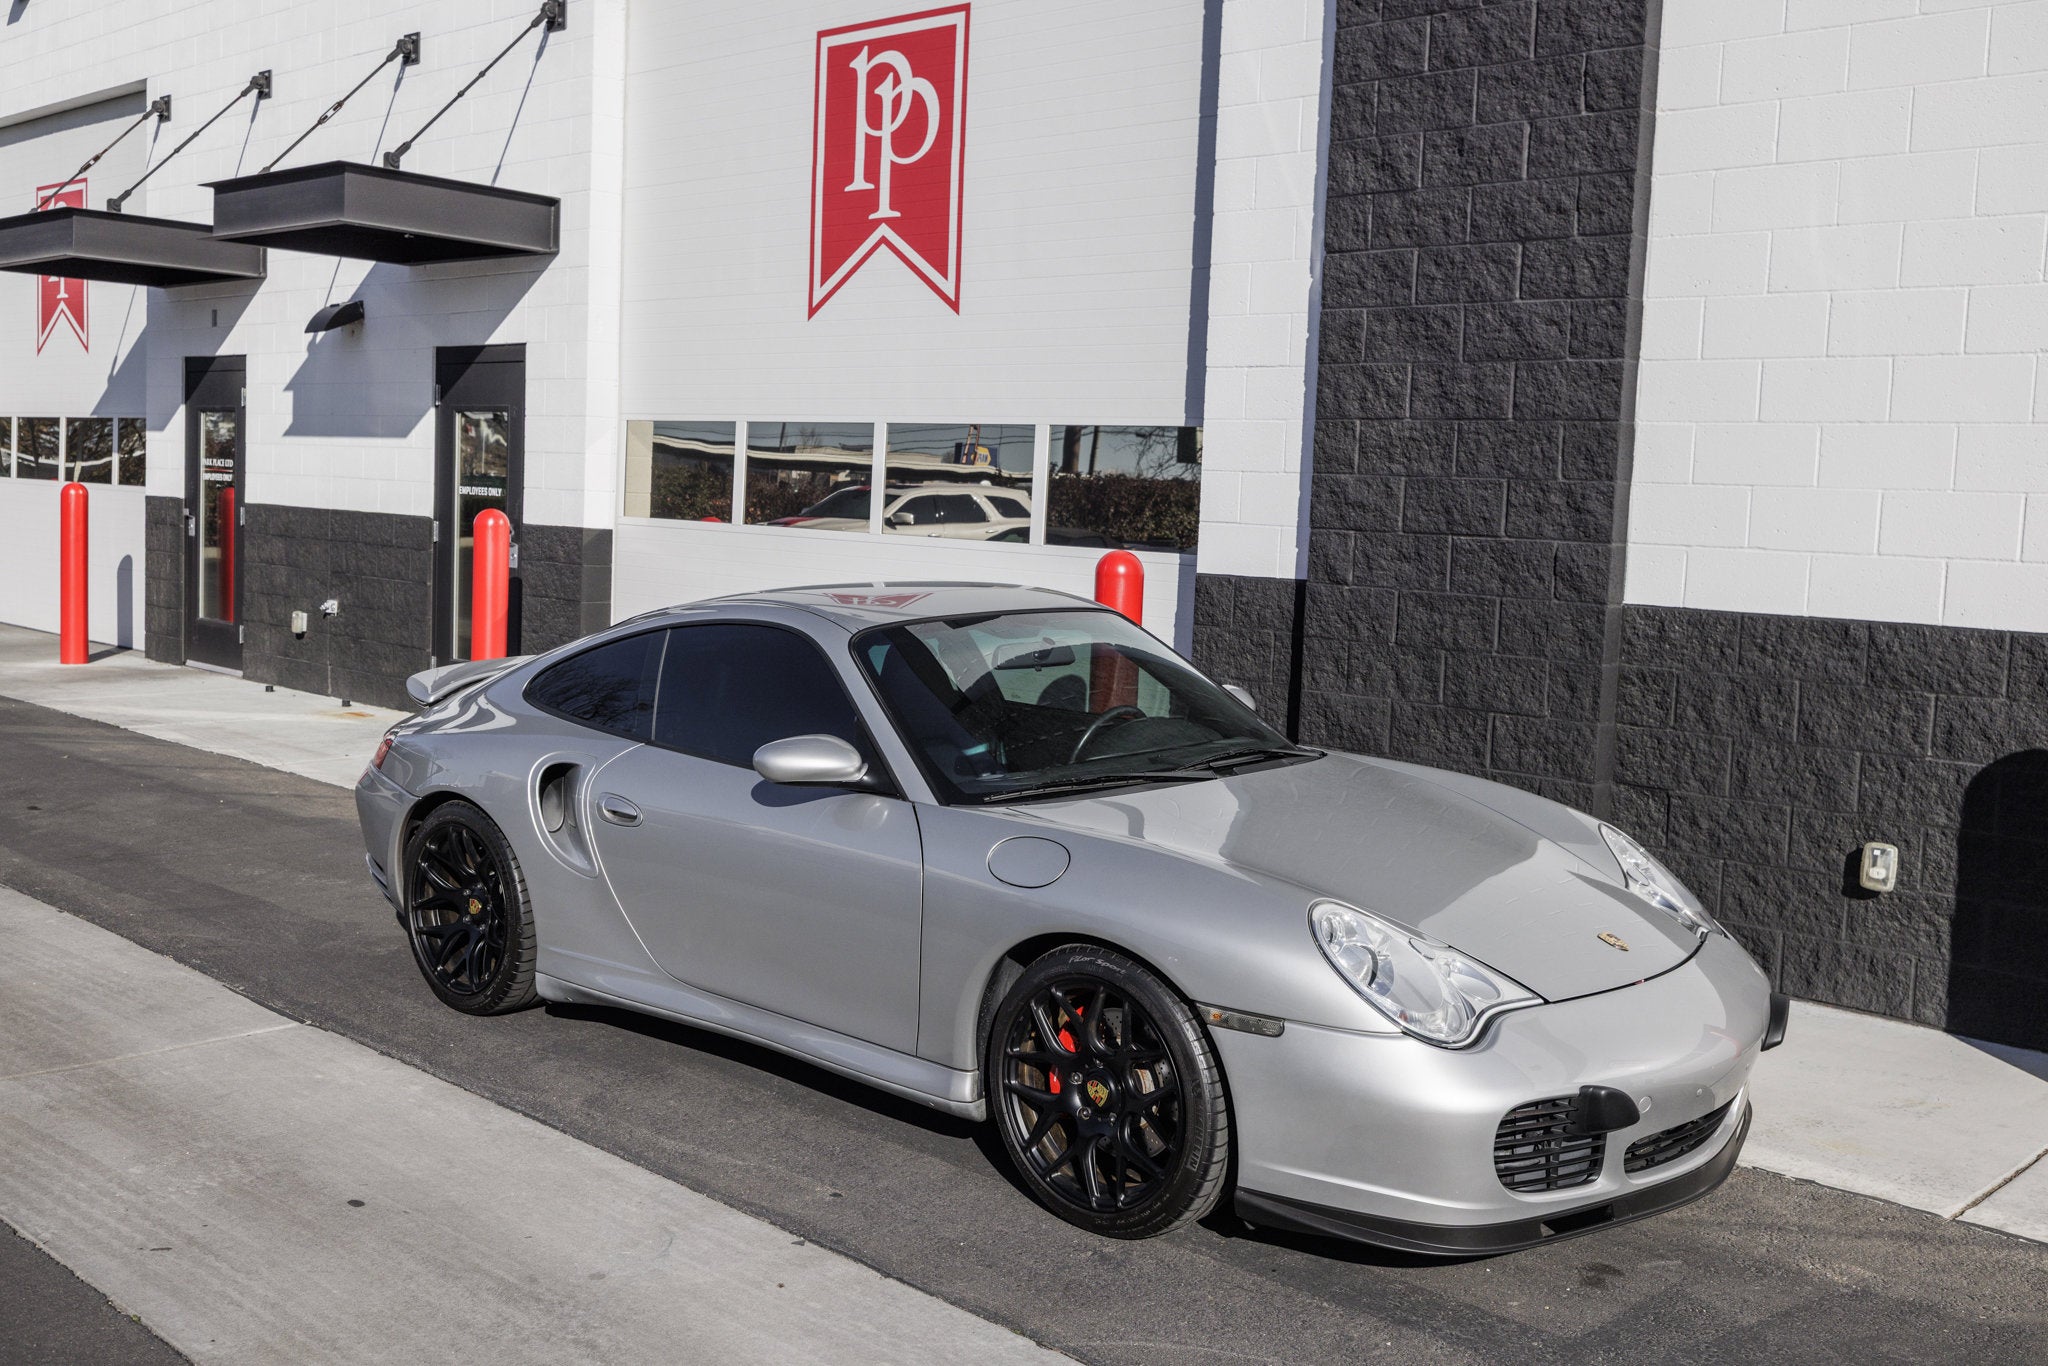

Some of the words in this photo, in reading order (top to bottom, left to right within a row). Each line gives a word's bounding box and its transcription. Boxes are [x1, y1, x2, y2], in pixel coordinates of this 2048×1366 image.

[203, 472, 223, 481] EMPLOYEES
[223, 473, 232, 481] ONLY
[459, 486, 487, 495] EMPLOYEES
[488, 487, 502, 496] ONLY
[1095, 959, 1127, 974] Sport
